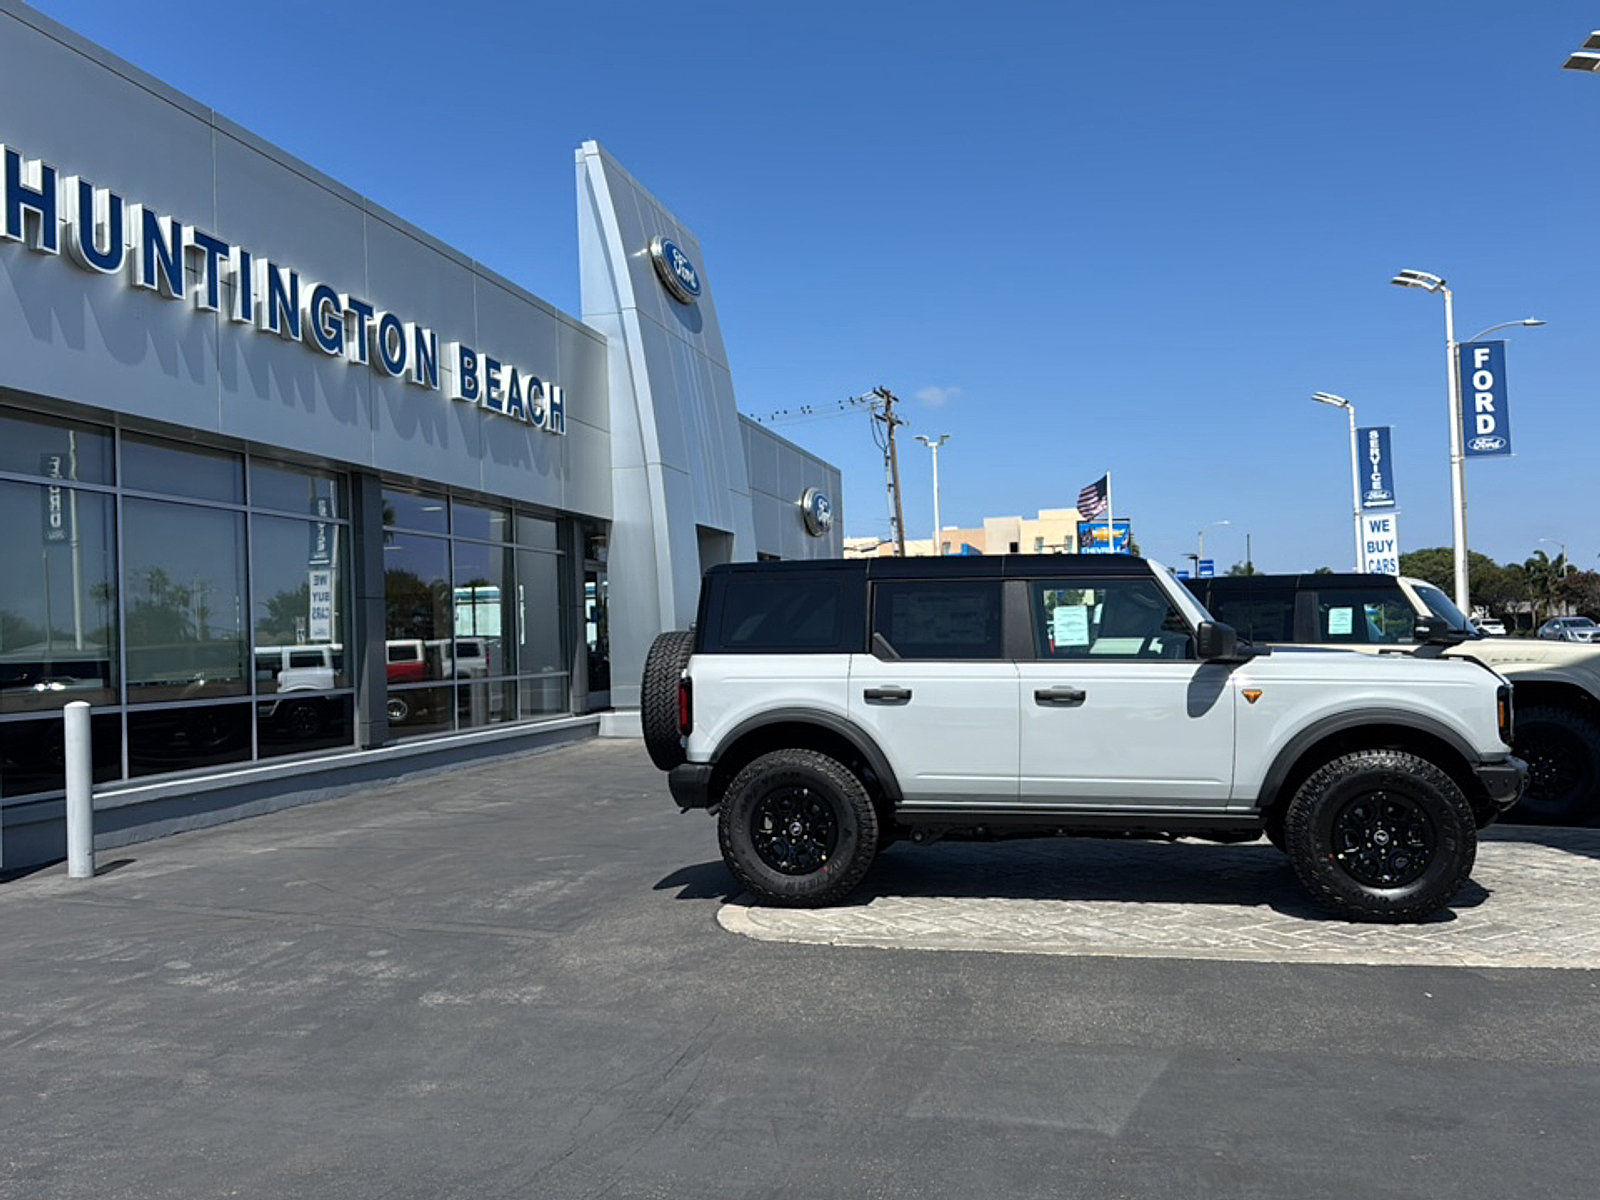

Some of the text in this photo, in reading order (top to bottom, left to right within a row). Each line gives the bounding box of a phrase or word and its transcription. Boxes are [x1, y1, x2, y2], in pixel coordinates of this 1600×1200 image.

[0, 144, 566, 435] HUNTINGTON BEACH
[1473, 348, 1496, 435] FORD
[1369, 430, 1383, 490] SERVICE
[1369, 519, 1391, 533] WE
[1367, 540, 1394, 553] BUY
[1368, 558, 1397, 574] CARS
